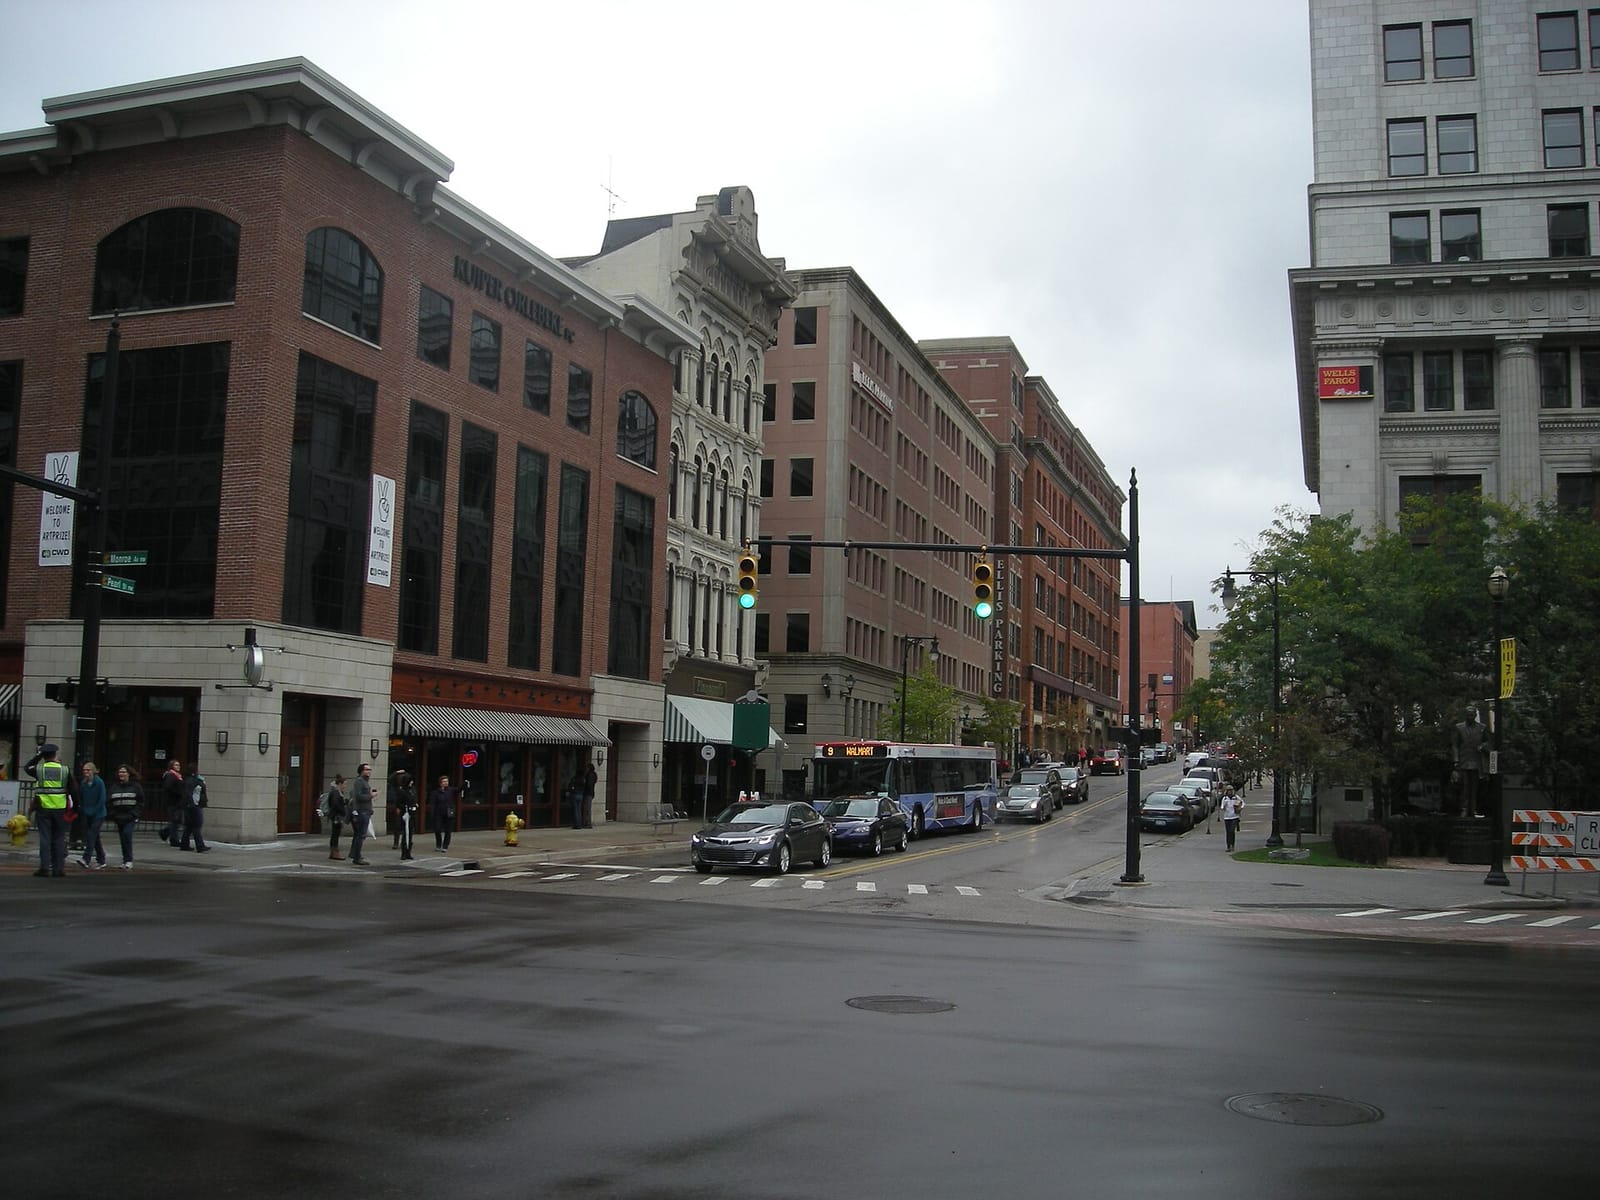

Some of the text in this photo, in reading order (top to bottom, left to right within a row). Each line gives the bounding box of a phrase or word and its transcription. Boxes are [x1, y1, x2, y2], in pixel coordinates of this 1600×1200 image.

[453, 254, 502, 302] KUIPER
[1323, 369, 1356, 378] WELLS
[1324, 377, 1355, 385] FARGO
[45, 505, 70, 515] WELCOME
[52, 518, 61, 528] TO
[42, 531, 70, 541] ARTPRIZE!
[110, 552, 132, 563] Monroe
[107, 577, 121, 589] Pearl
[993, 560, 1004, 693] ELLIS PARKING
[827, 746, 874, 757] 9 WALMART
[1551, 822, 1575, 832] ROA
[1589, 821, 1598, 833] R
[1581, 837, 1600, 850] CL
